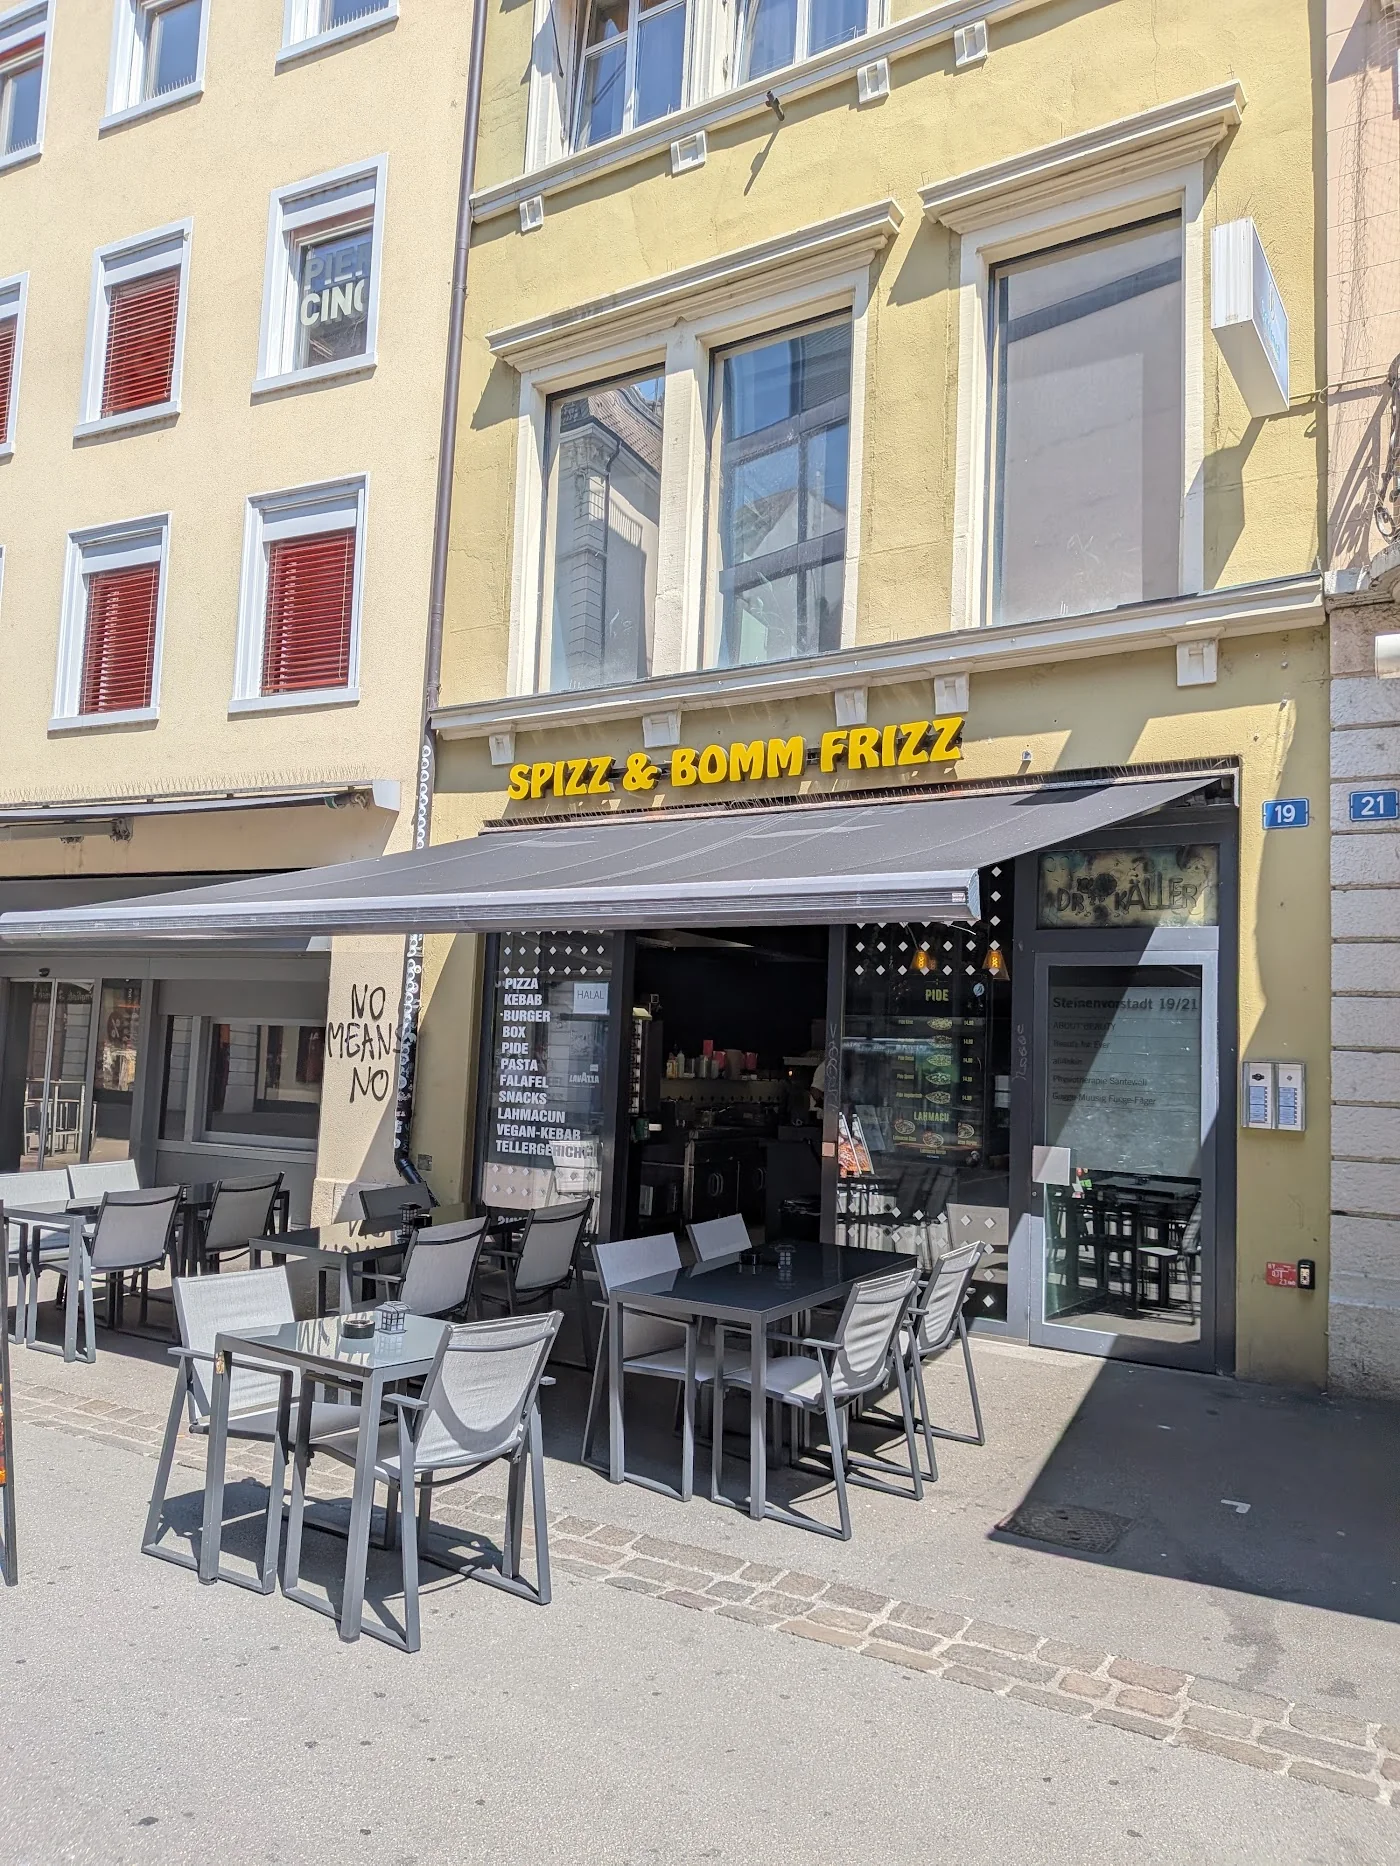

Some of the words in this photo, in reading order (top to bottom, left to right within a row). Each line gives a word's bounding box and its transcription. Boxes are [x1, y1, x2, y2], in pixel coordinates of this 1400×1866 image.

[508, 756, 616, 801] SPIZZ
[622, 752, 662, 792] &
[671, 736, 806, 788] BOMM
[820, 716, 966, 774] FRIZZ
[1360, 795, 1385, 816] 21
[1274, 804, 1296, 823] 19
[505, 978, 539, 990] PIZZA
[352, 984, 385, 1020] NO
[504, 993, 543, 1006] KEBAB
[577, 990, 605, 1000] HALAL
[925, 989, 949, 1001] PIDE
[1053, 997, 1153, 1011] Steinenvorstadt
[1159, 998, 1198, 1011] 19/21
[503, 1010, 551, 1022] BURGER
[502, 1026, 526, 1038] BOX
[501, 1042, 529, 1054] PIDE
[500, 1058, 538, 1071] PASTA
[349, 1066, 389, 1104] NO
[500, 1074, 549, 1088] FALAFEL
[499, 1090, 547, 1105] SNACKS
[497, 1107, 566, 1123] LAHMACUN
[496, 1123, 581, 1141] VEGAN-KEBAB
